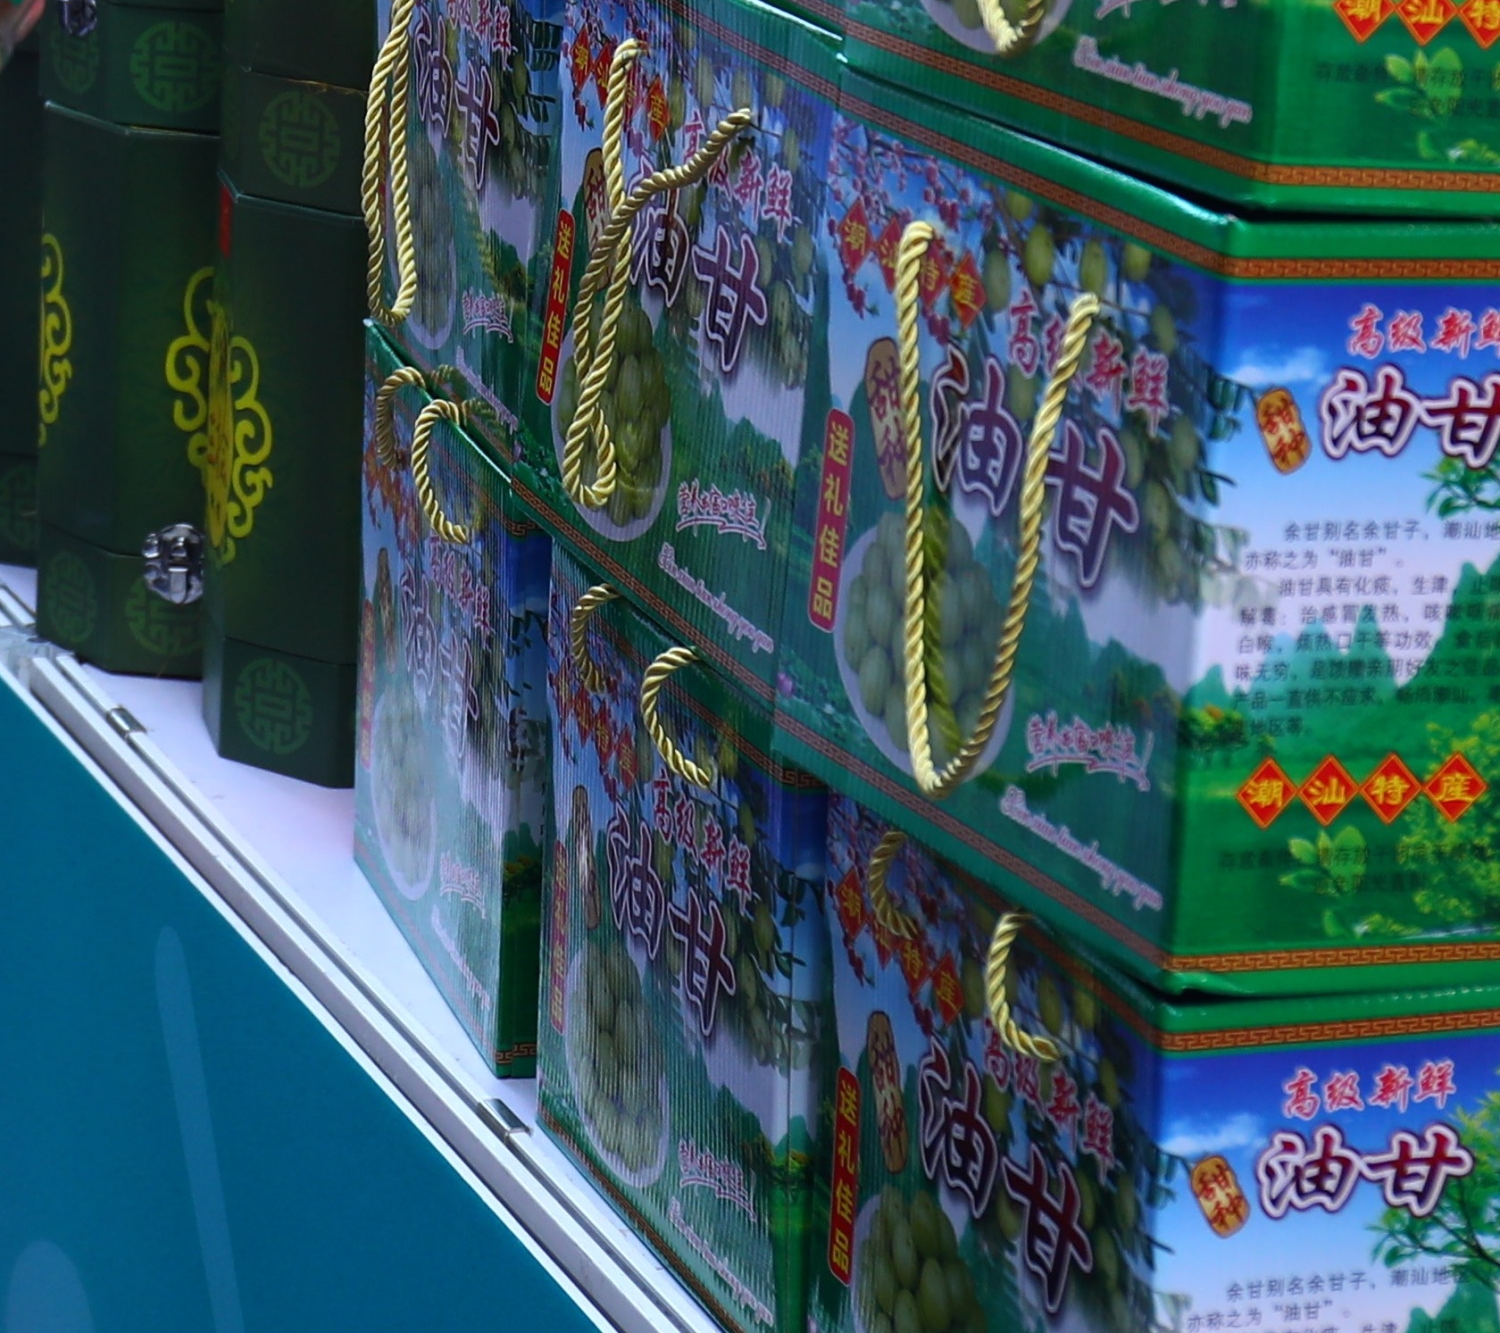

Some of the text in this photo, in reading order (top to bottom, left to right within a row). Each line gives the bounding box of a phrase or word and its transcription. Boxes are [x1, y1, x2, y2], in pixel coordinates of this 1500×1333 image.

[413, 4, 500, 190] 油甘
[539, 222, 573, 395] 送礼佳品
[629, 155, 767, 373] 油甘
[931, 343, 1139, 588] 油甘
[607, 801, 736, 1036] 油甘
[833, 1083, 859, 1271] 送礼佳品
[920, 1038, 1093, 1315] 油甘
[1257, 1122, 1475, 1220] 油甘
[1281, 1058, 1456, 1120] 高级新鲜
